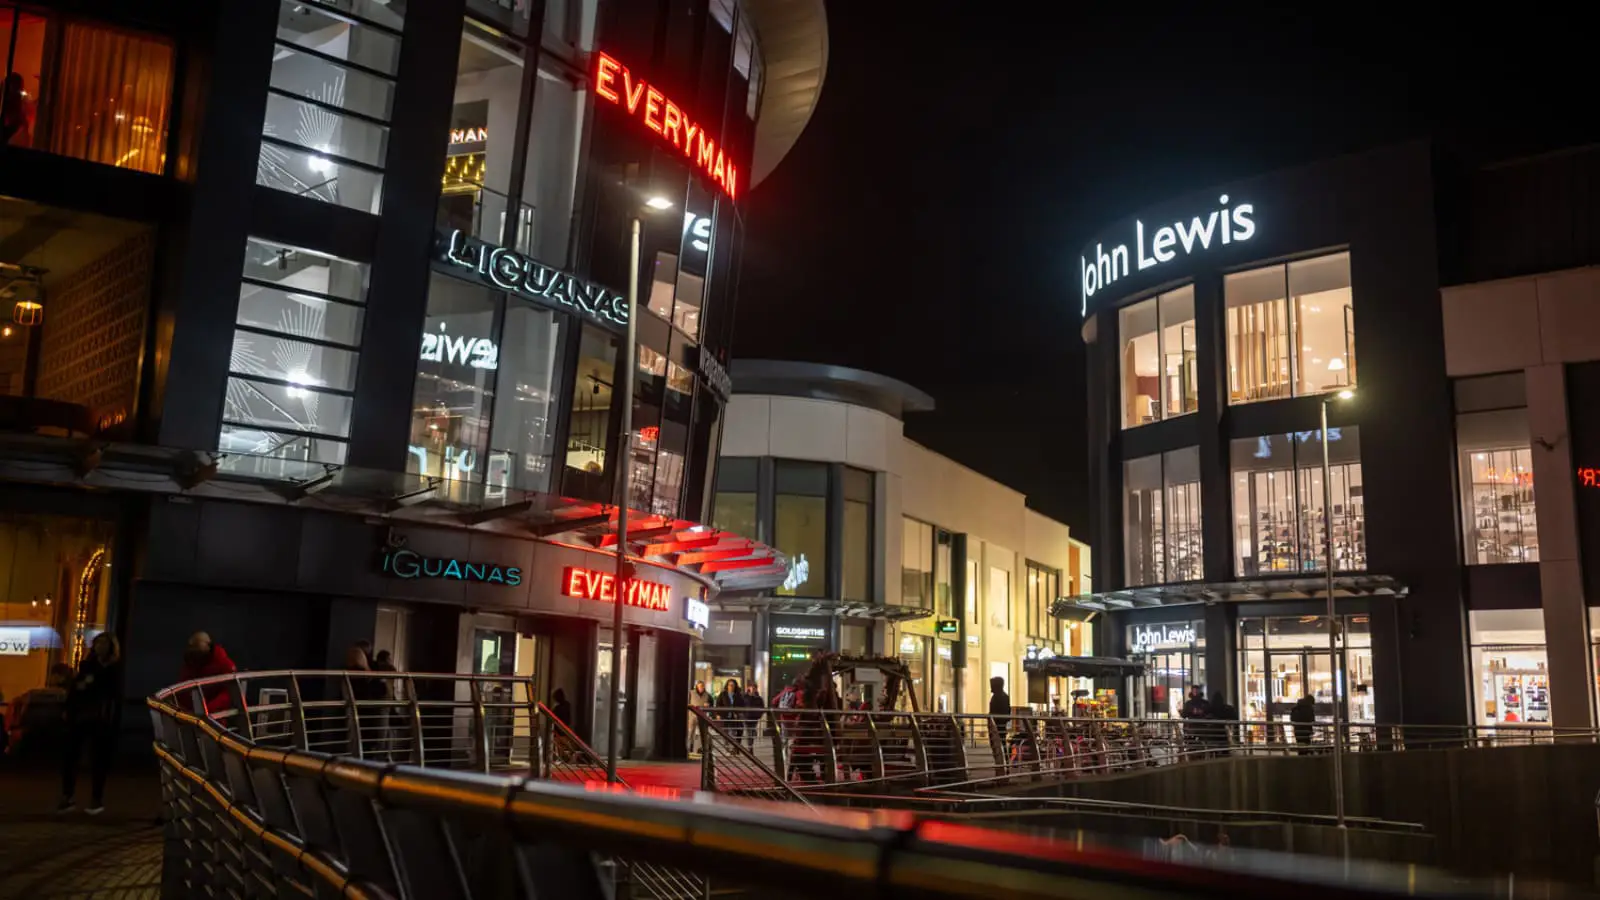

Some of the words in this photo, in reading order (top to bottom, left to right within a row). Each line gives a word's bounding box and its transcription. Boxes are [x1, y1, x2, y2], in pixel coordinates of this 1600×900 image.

[596, 51, 736, 204] EVERYMAN
[1081, 242, 1129, 318] John
[1136, 194, 1256, 270] Lewis
[776, 626, 825, 637] GOLDSMITHS
[1136, 625, 1161, 646] John
[1162, 624, 1195, 643] Lewis
